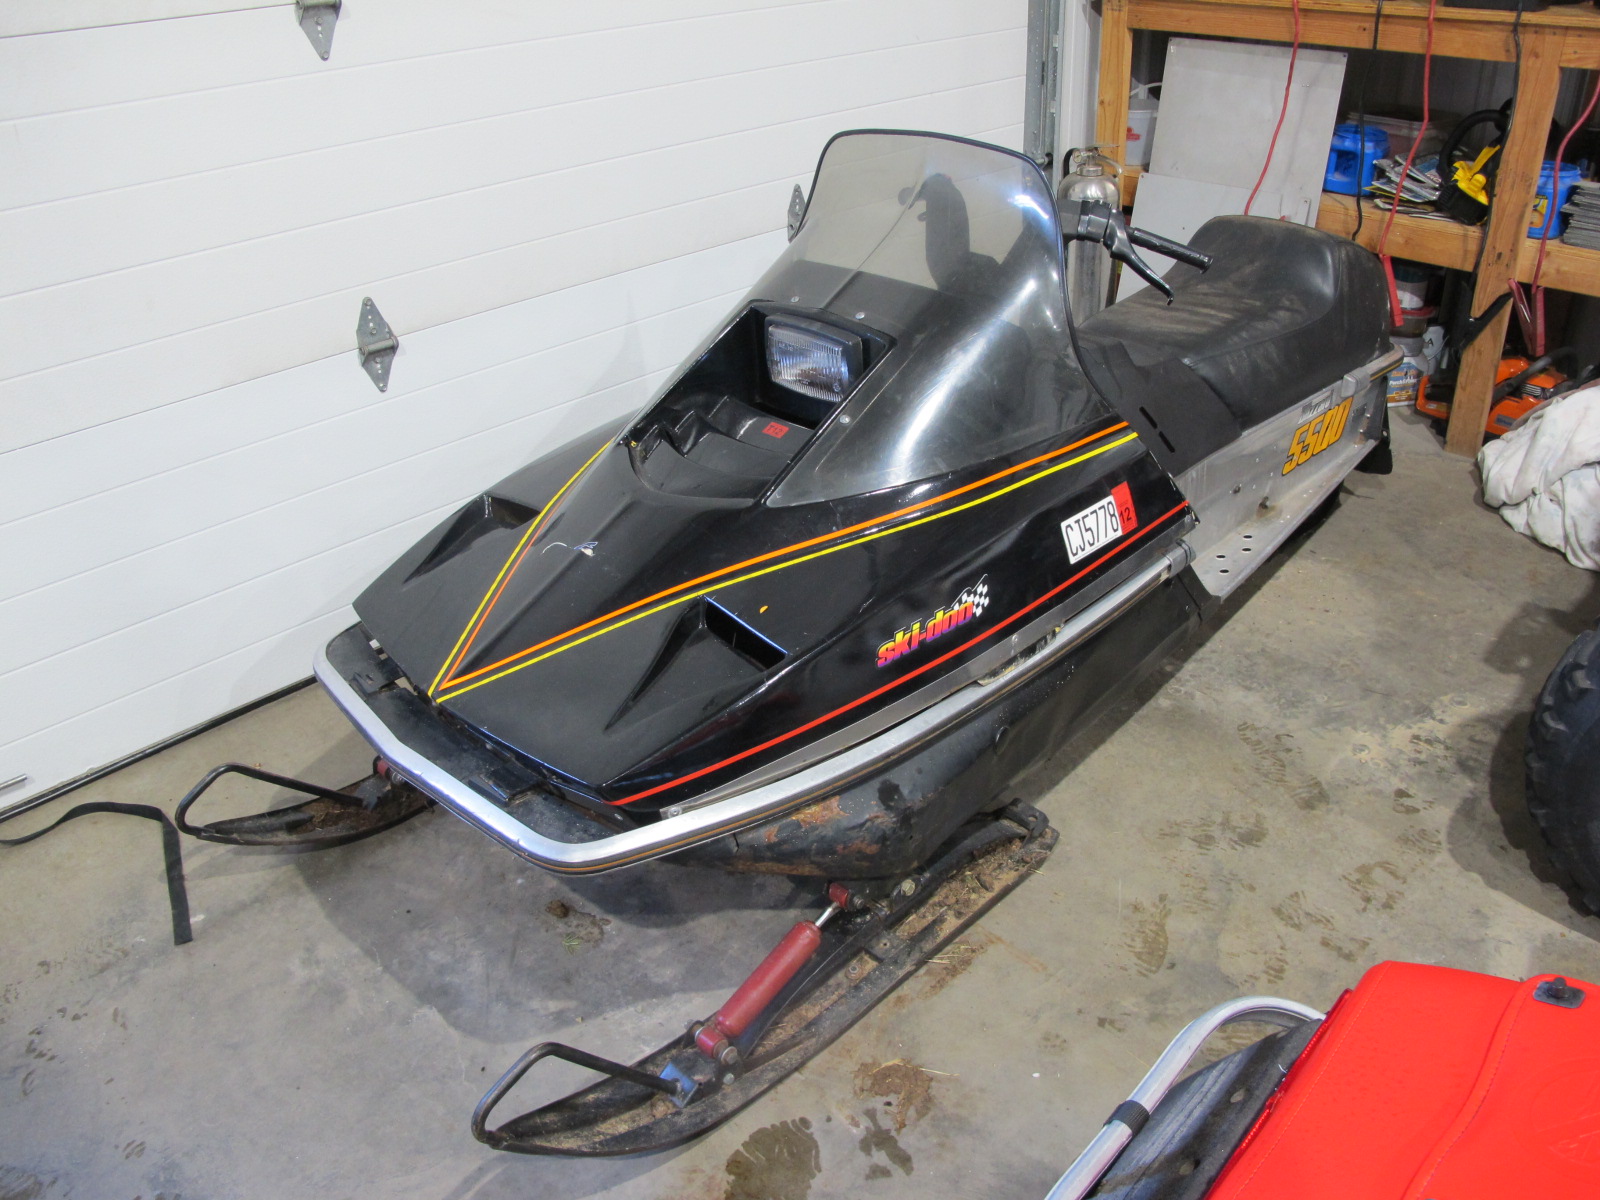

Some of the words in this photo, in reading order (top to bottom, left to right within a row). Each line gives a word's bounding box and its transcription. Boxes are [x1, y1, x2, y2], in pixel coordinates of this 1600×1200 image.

[1282, 396, 1354, 476] 5500
[1065, 500, 1119, 557] CJ5778
[1119, 507, 1132, 524] 12
